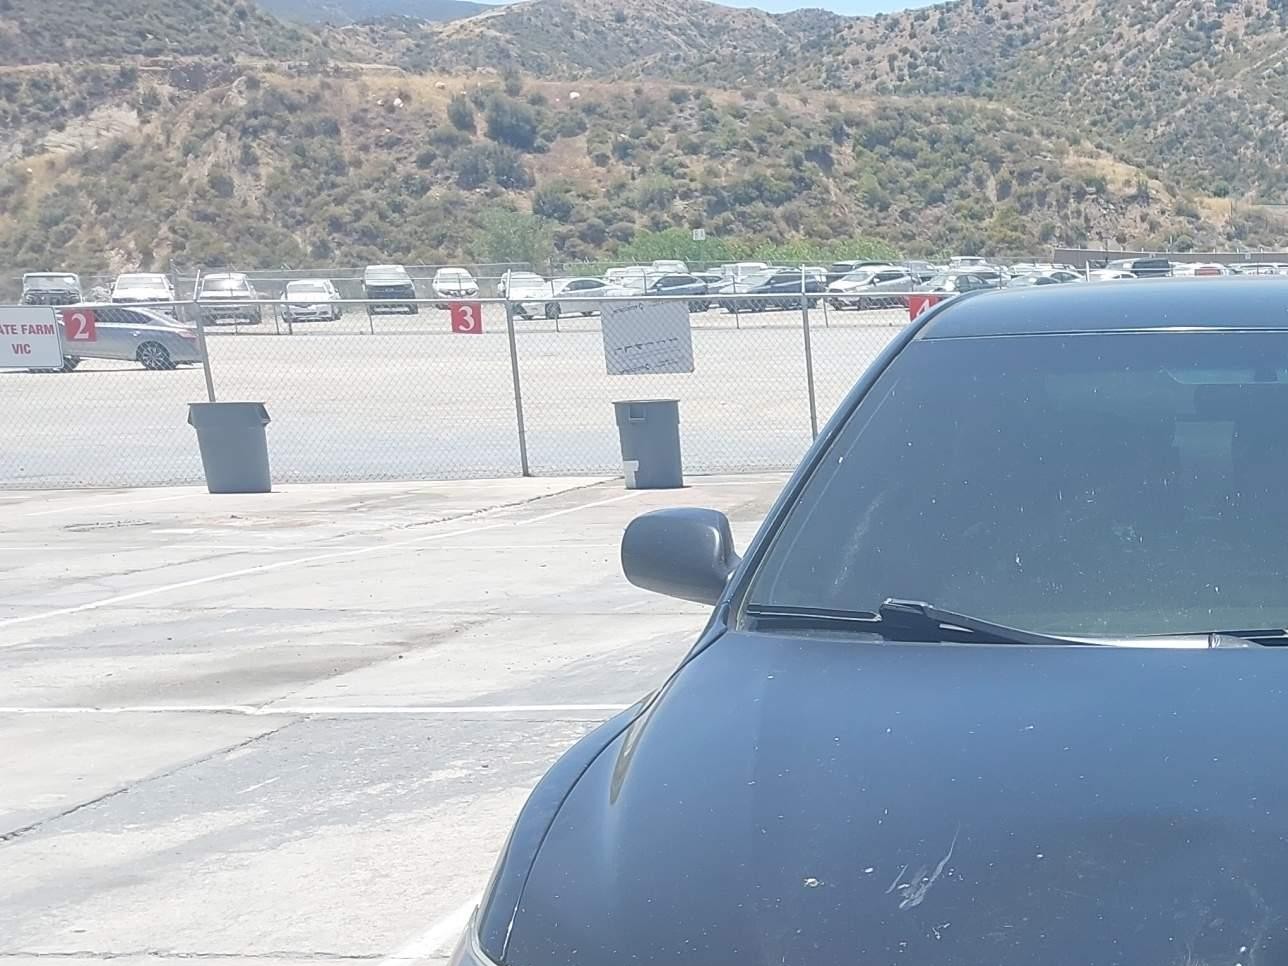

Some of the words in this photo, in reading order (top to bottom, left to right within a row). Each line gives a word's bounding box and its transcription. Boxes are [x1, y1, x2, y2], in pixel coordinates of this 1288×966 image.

[71, 313, 90, 339] 2
[458, 305, 475, 331] 3
[21, 324, 55, 335] FARM
[11, 343, 32, 354] VIC
